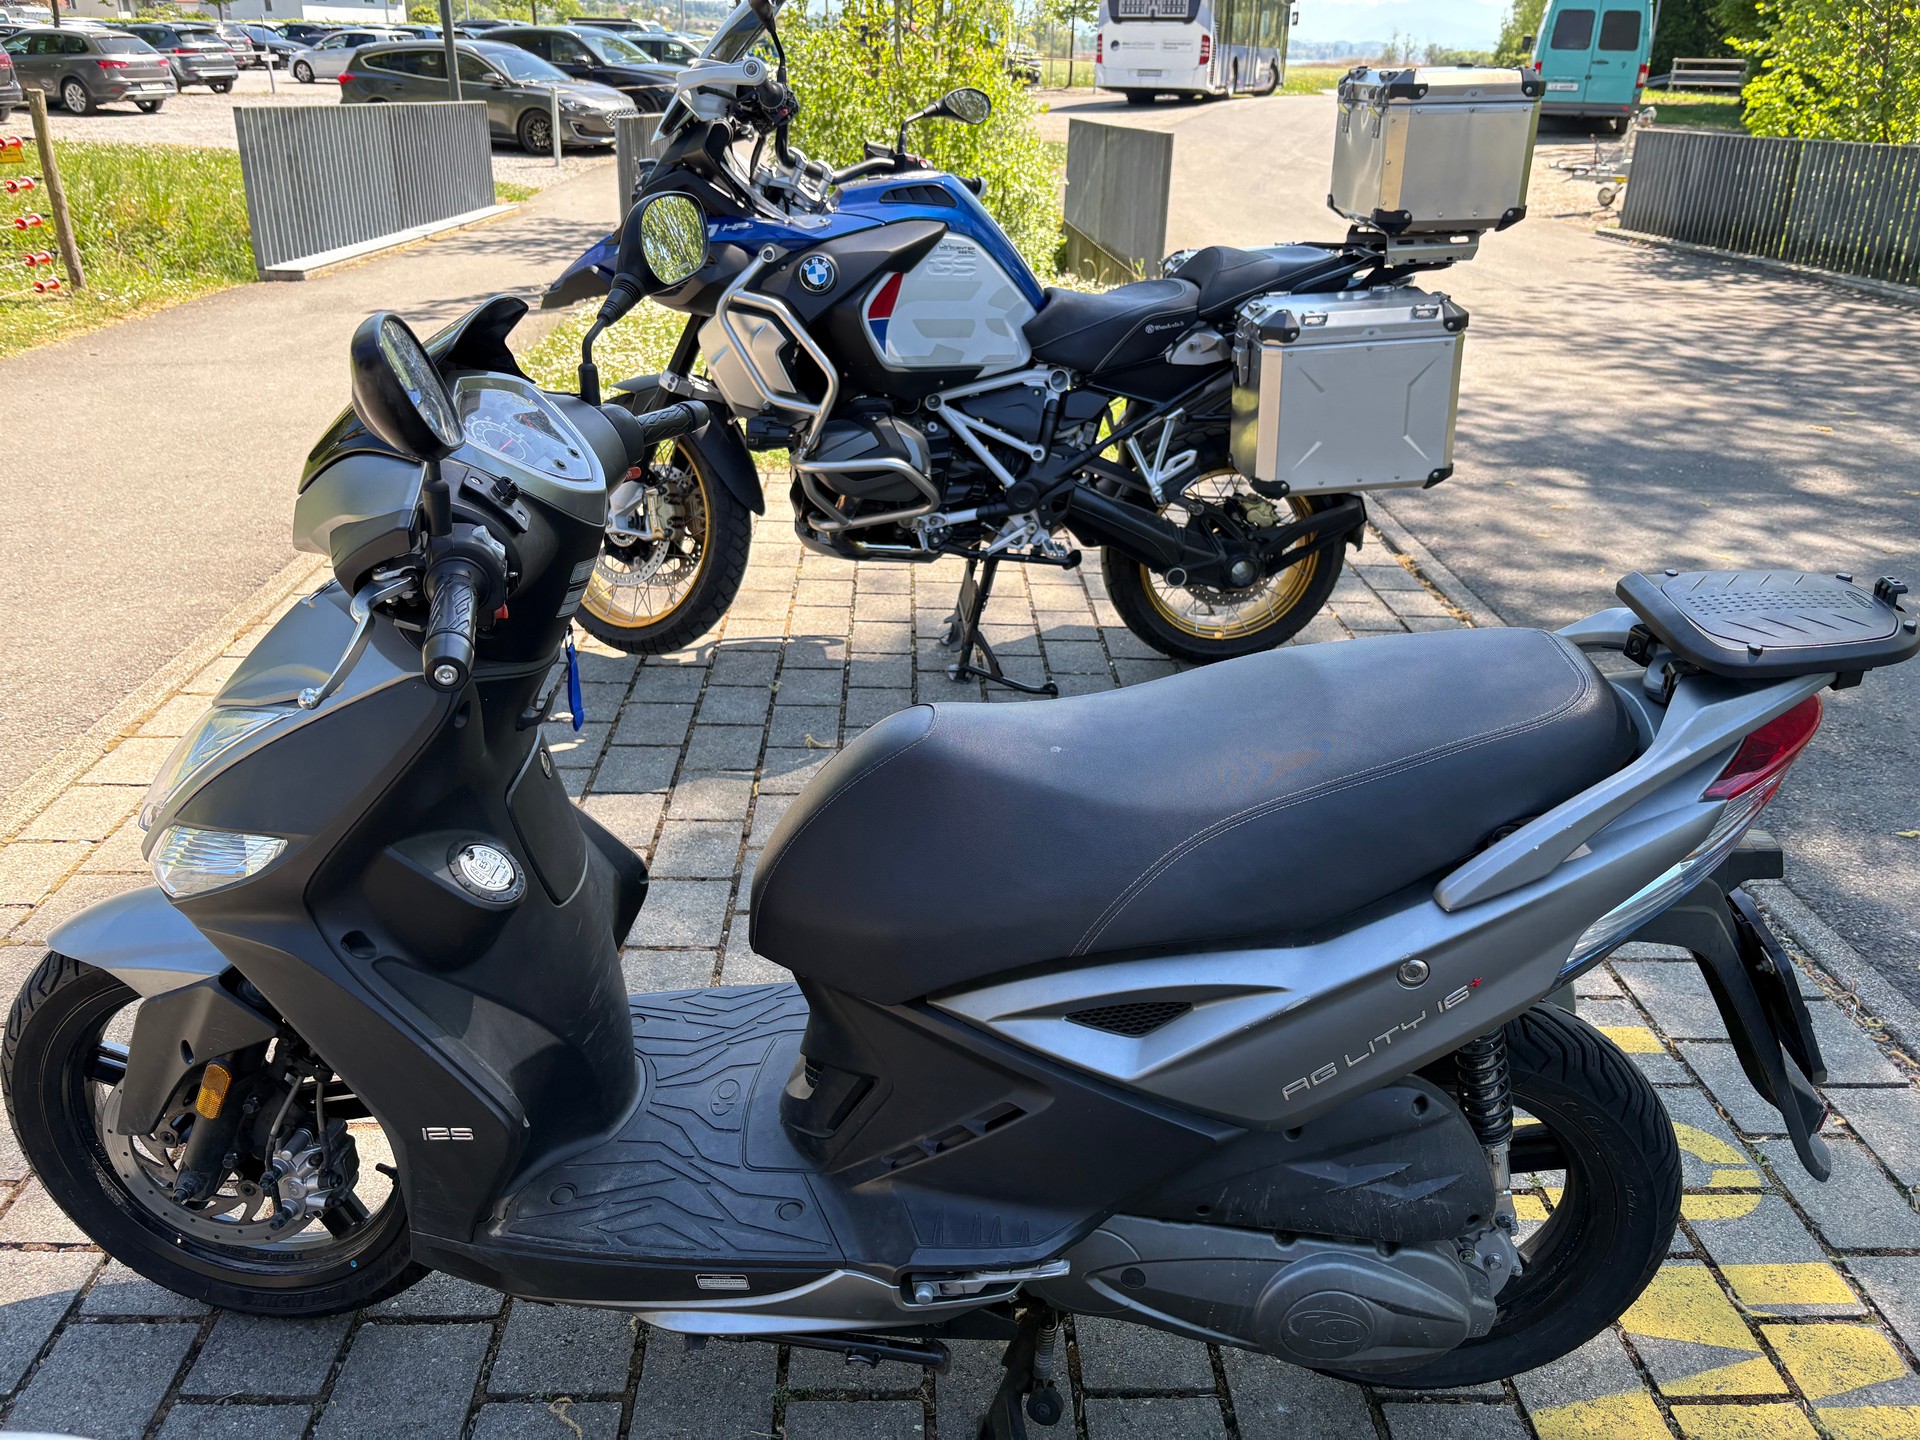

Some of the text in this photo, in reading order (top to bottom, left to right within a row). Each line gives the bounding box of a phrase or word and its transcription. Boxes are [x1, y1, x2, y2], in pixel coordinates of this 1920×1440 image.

[927, 254, 977, 276] GS
[478, 859, 488, 870] E5
[421, 1126, 474, 1141] 125
